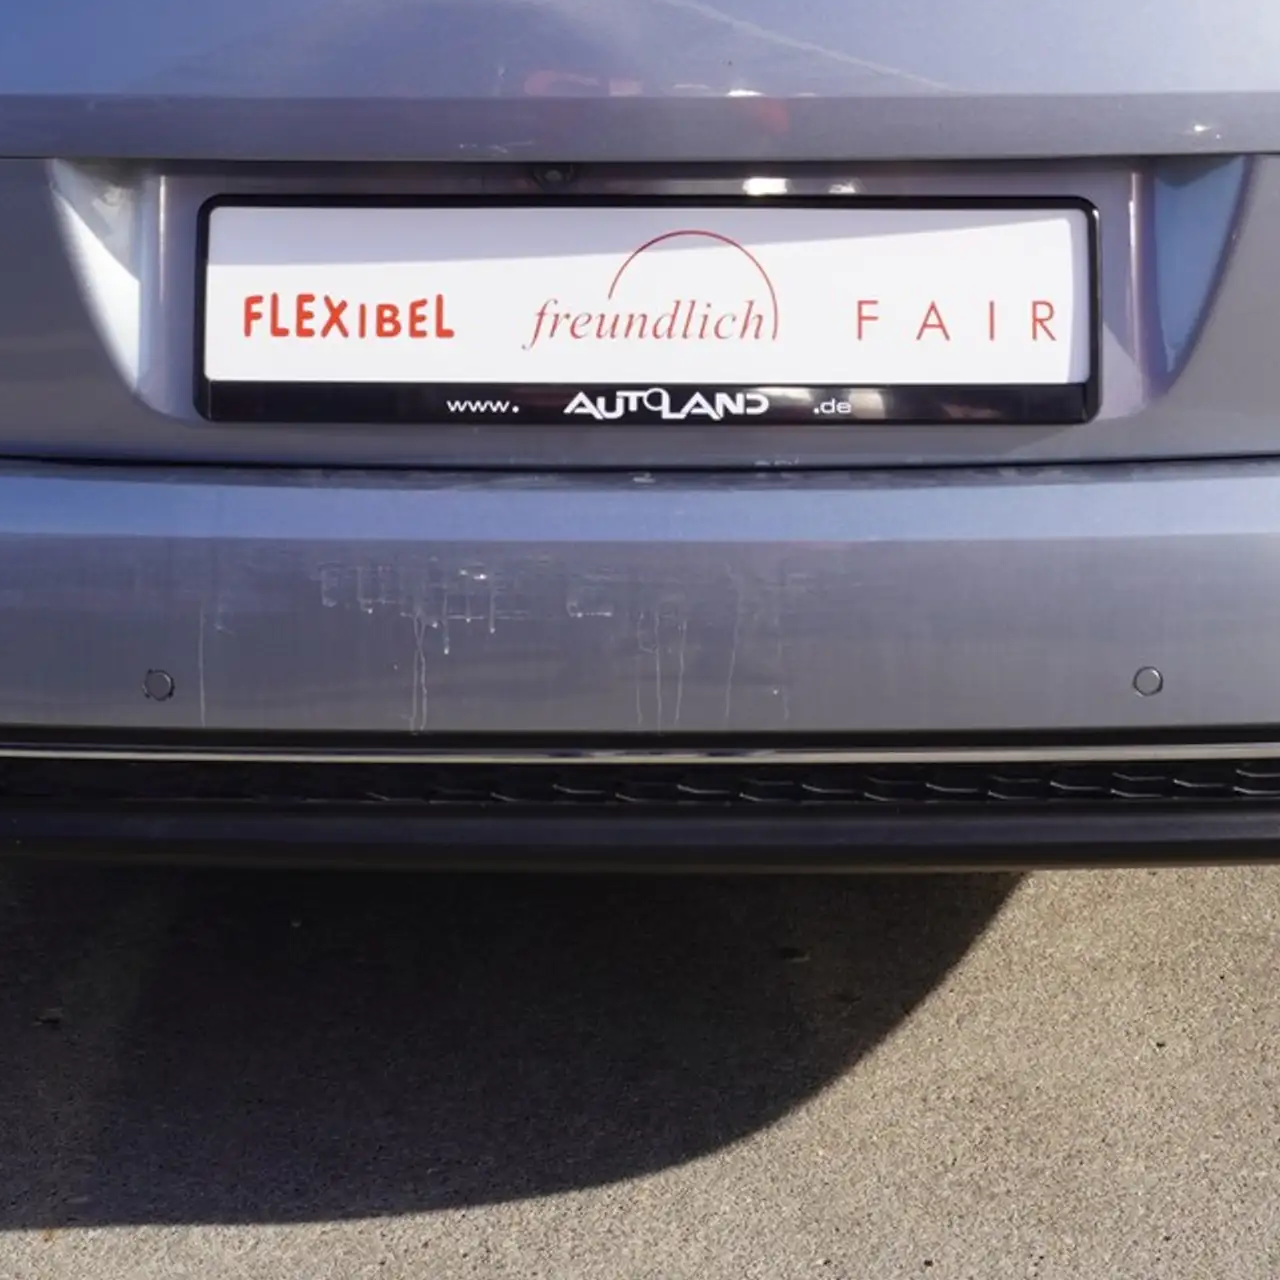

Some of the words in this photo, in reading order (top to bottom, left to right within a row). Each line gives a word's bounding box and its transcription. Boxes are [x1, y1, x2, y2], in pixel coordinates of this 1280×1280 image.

[243, 293, 456, 339] FLEXIBEL
[521, 298, 766, 351] freundlich
[446, 400, 520, 414] www.
